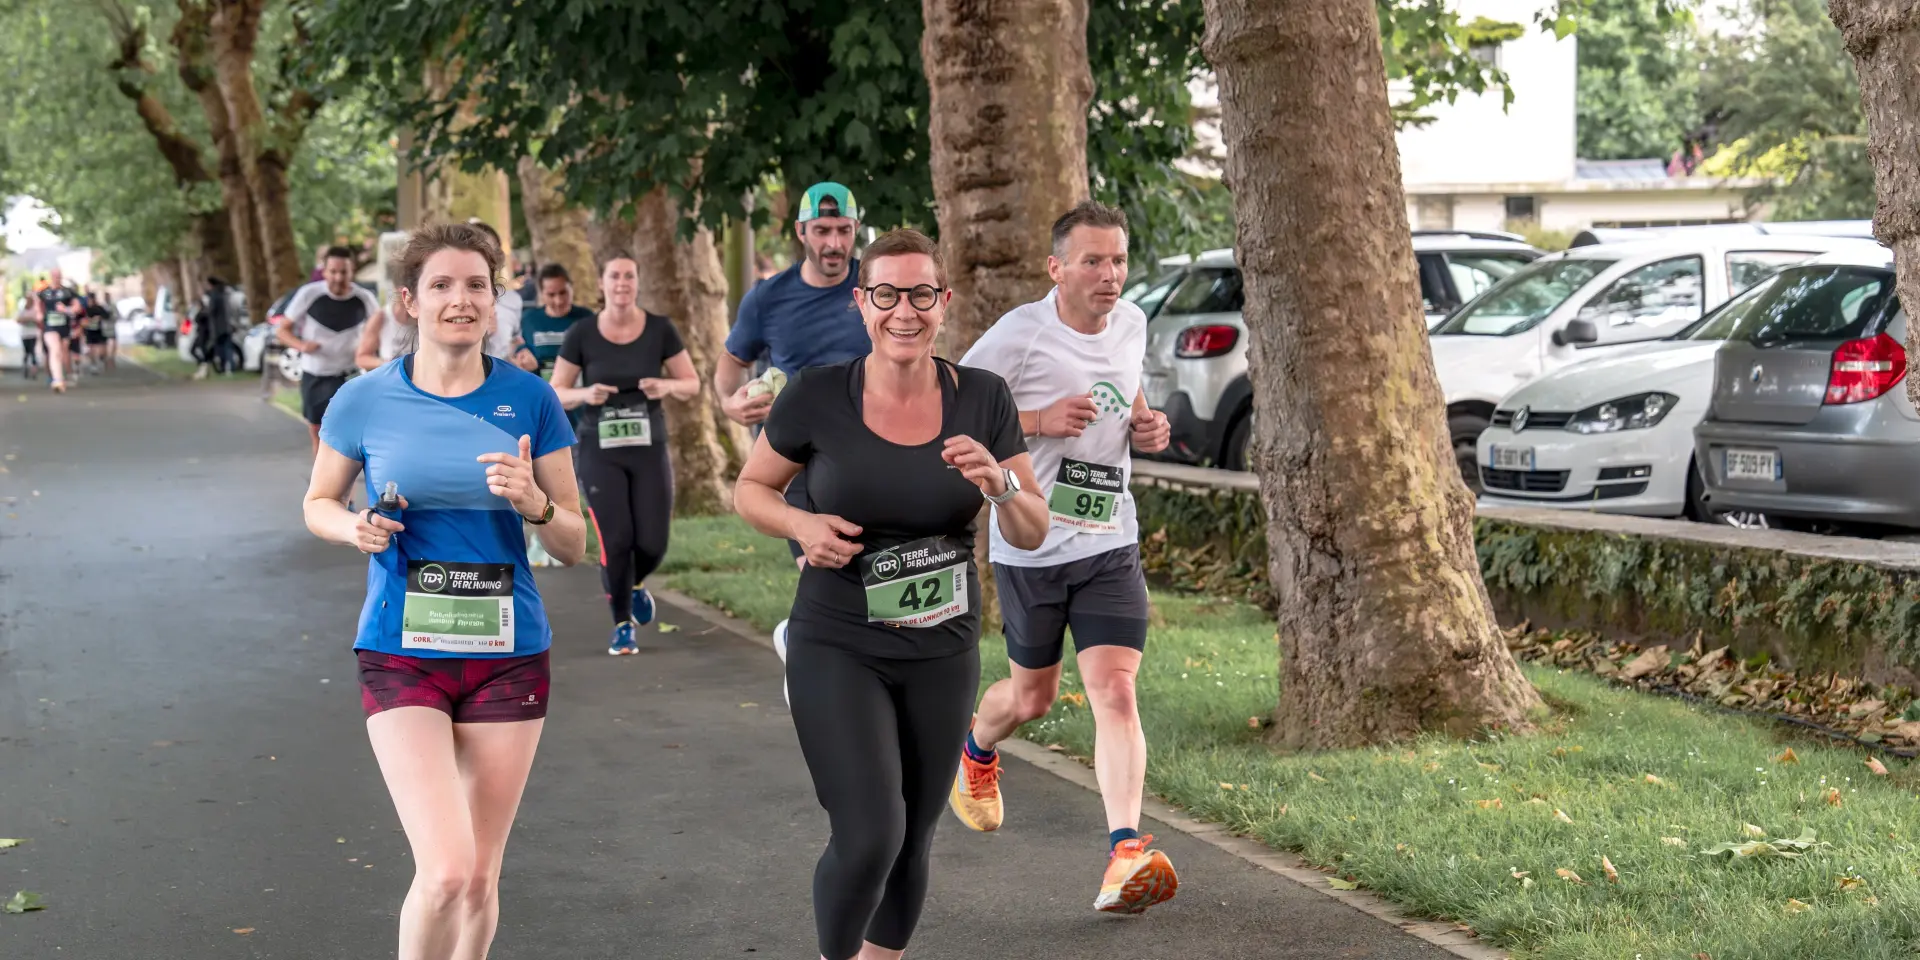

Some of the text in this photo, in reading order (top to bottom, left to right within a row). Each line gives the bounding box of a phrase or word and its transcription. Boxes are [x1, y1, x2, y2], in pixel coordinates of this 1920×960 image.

[608, 422, 642, 437] 319
[1070, 469, 1087, 480] TDR
[1090, 470, 1108, 478] TERRE
[1074, 493, 1106, 518] 95
[901, 548, 929, 562] TERRE
[915, 550, 957, 568] RUNNING
[876, 560, 898, 573] TDR
[423, 572, 443, 584] TDR
[449, 571, 479, 581] TERRE
[899, 577, 942, 610] 42
